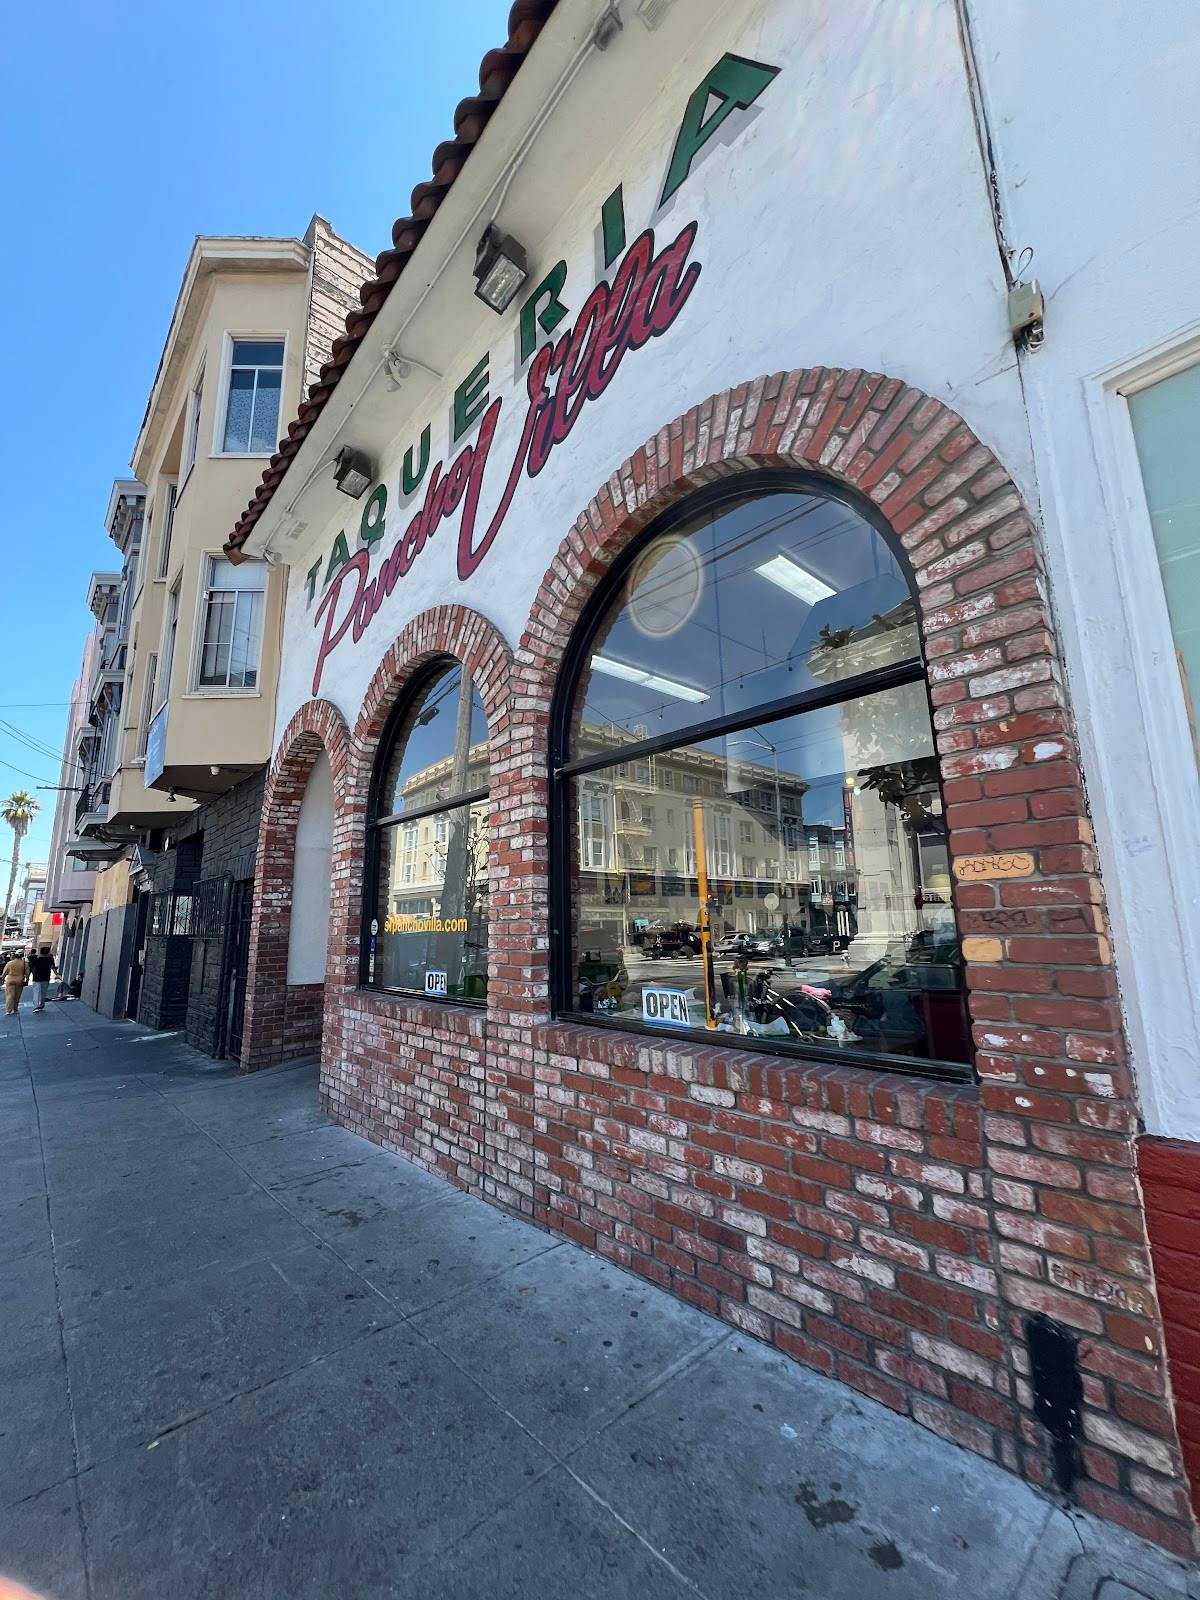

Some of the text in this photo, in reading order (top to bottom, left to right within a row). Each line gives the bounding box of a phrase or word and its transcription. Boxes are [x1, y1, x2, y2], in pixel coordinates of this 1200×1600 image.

[306, 52, 782, 602] TAQUERIA
[312, 220, 701, 697] Pancho Villa
[645, 992, 688, 1022] OPEN
